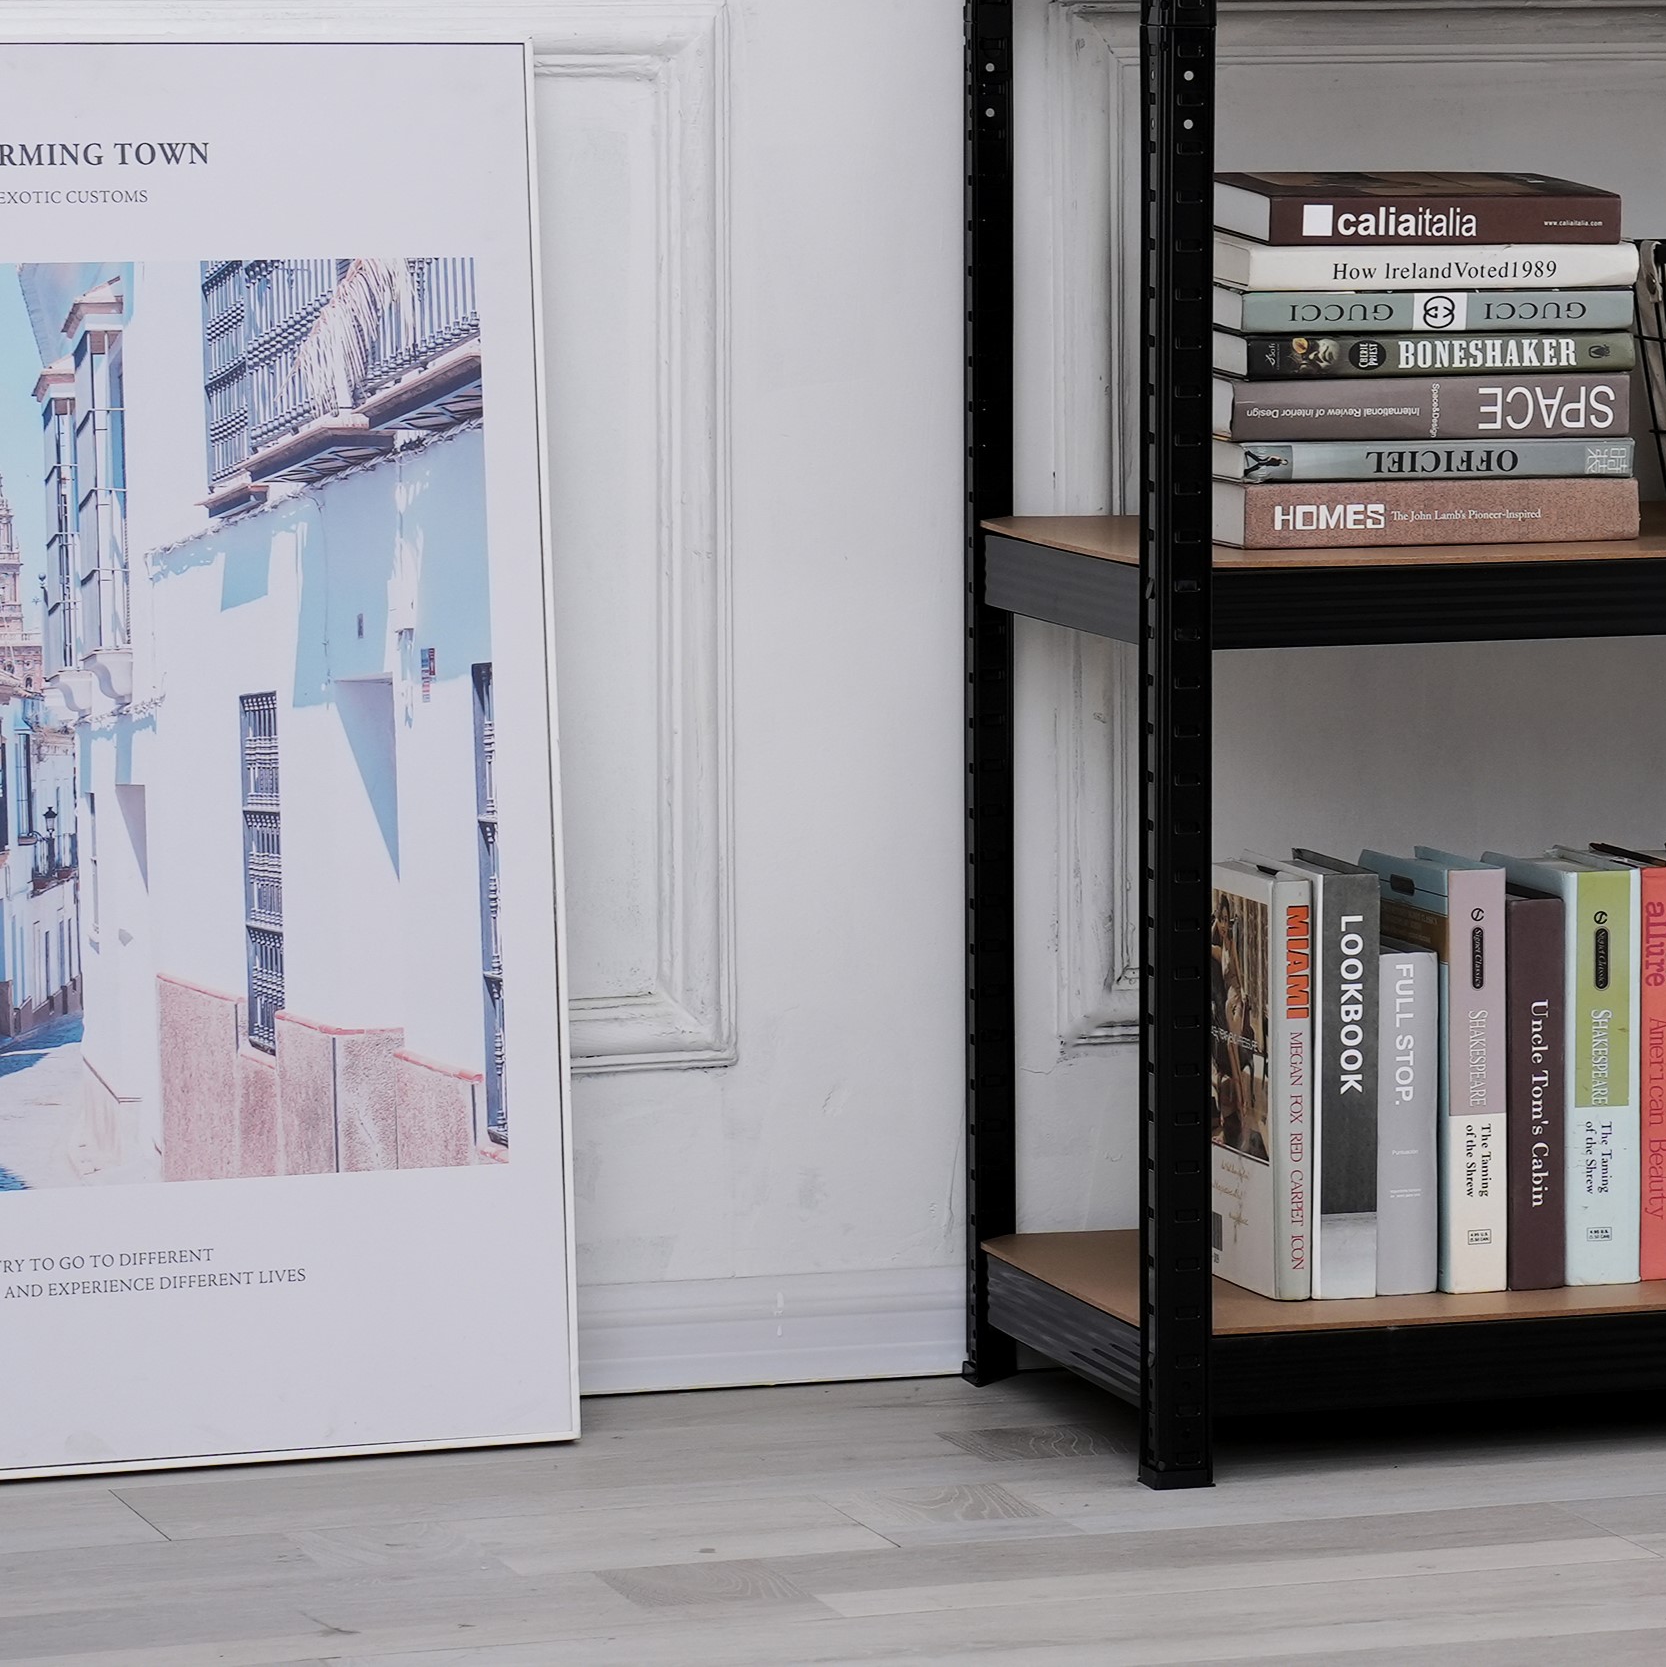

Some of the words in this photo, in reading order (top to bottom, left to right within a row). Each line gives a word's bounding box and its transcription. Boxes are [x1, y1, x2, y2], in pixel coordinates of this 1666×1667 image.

[114, 142, 209, 165] TOWN
[0, 191, 61, 204] EXOTIC
[66, 190, 148, 203] CUSTOMS
[1337, 206, 1477, 237] caliaitalia
[1333, 263, 1376, 280] How
[1289, 304, 1394, 322] GUCCI
[1484, 301, 1587, 319] GUCCI
[1398, 338, 1576, 369] BONESHAKER
[1247, 407, 1278, 418] Design
[1316, 407, 1324, 417] of
[1327, 407, 1360, 417] Review
[1364, 407, 1420, 416] International
[1478, 385, 1615, 430] SPACE
[1366, 449, 1518, 474] OFFICIEL
[1274, 504, 1384, 530] HOMES
[1392, 510, 1410, 520] The
[1411, 510, 1431, 522] John
[1468, 508, 1540, 522] Pioneer-Inspired
[1287, 905, 1309, 1019] MIAMI
[1340, 916, 1363, 1094] LOOKBOOK
[1396, 964, 1414, 1027] FULL
[1531, 1000, 1548, 1064] Uncle
[1290, 1033, 1302, 1086] MEGAN
[1396, 1035, 1414, 1105] STOP.
[1468, 1010, 1488, 1107] SHAKESPEARE
[1591, 1010, 1612, 1105] SHAKESPEARE
[1290, 1095, 1303, 1124] FOX
[1532, 1070, 1549, 1136] Tom's
[1466, 1125, 1475, 1137] of
[1481, 1124, 1491, 1148] The
[1290, 1133, 1303, 1162] RED
[1466, 1138, 1475, 1158] the
[1466, 1162, 1476, 1198] Shrew
[1479, 1152, 1492, 1198] Taming
[1532, 1142, 1549, 1208] Cabin
[1290, 1170, 1304, 1226] CARPET
[30, 1257, 54, 1271] TO
[60, 1256, 84, 1270] GO
[90, 1254, 114, 1268] TO
[120, 1248, 214, 1266] DIFFERENT
[1291, 1235, 1304, 1270] ICON
[4, 1284, 43, 1298] AND
[48, 1278, 155, 1296] EXPERIENCE
[160, 1271, 253, 1290] DIFFERENT
[259, 1268, 306, 1283] LIVES
